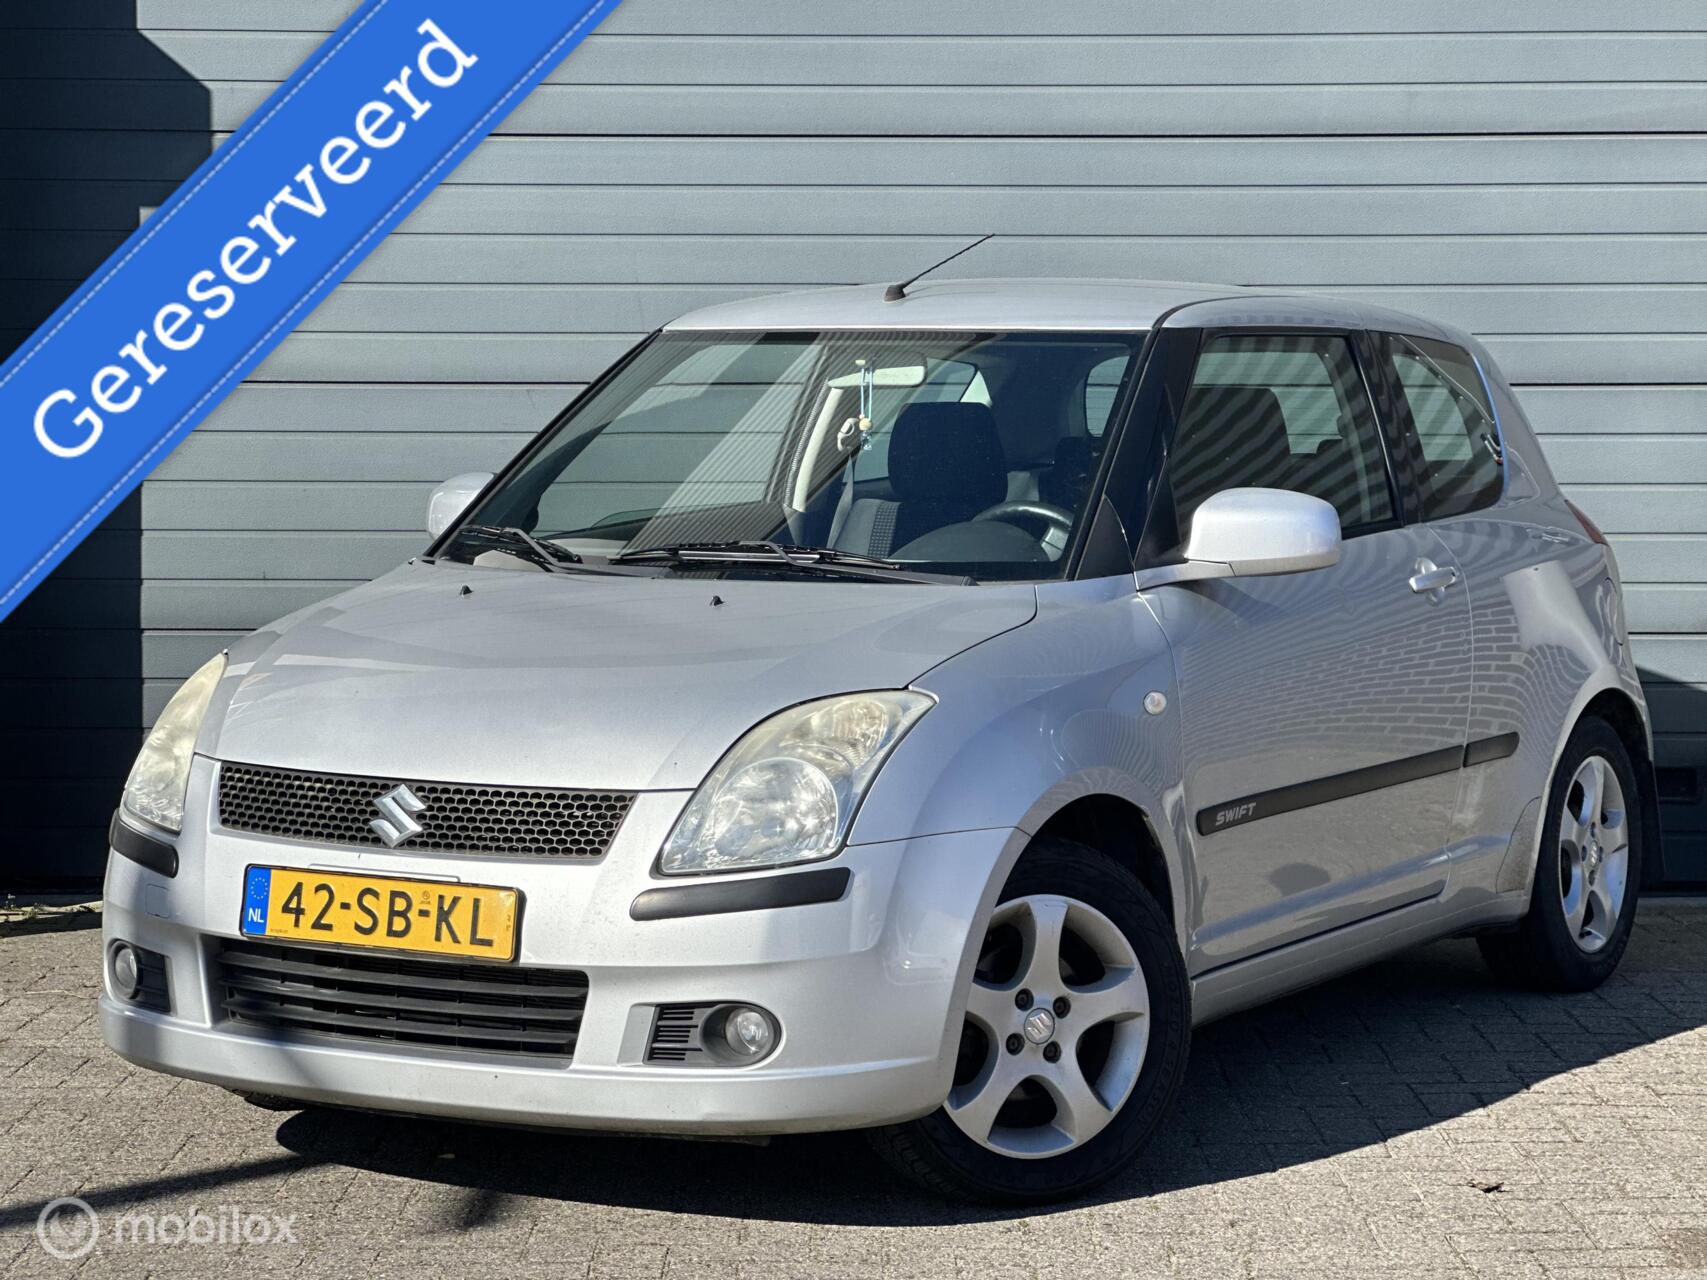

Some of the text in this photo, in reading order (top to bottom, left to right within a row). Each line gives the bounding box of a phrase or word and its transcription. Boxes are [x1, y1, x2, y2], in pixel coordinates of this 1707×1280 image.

[1215, 802, 1257, 826] SWIFT
[248, 907, 265, 924] NL
[281, 881, 494, 947] 42-SB-KL
